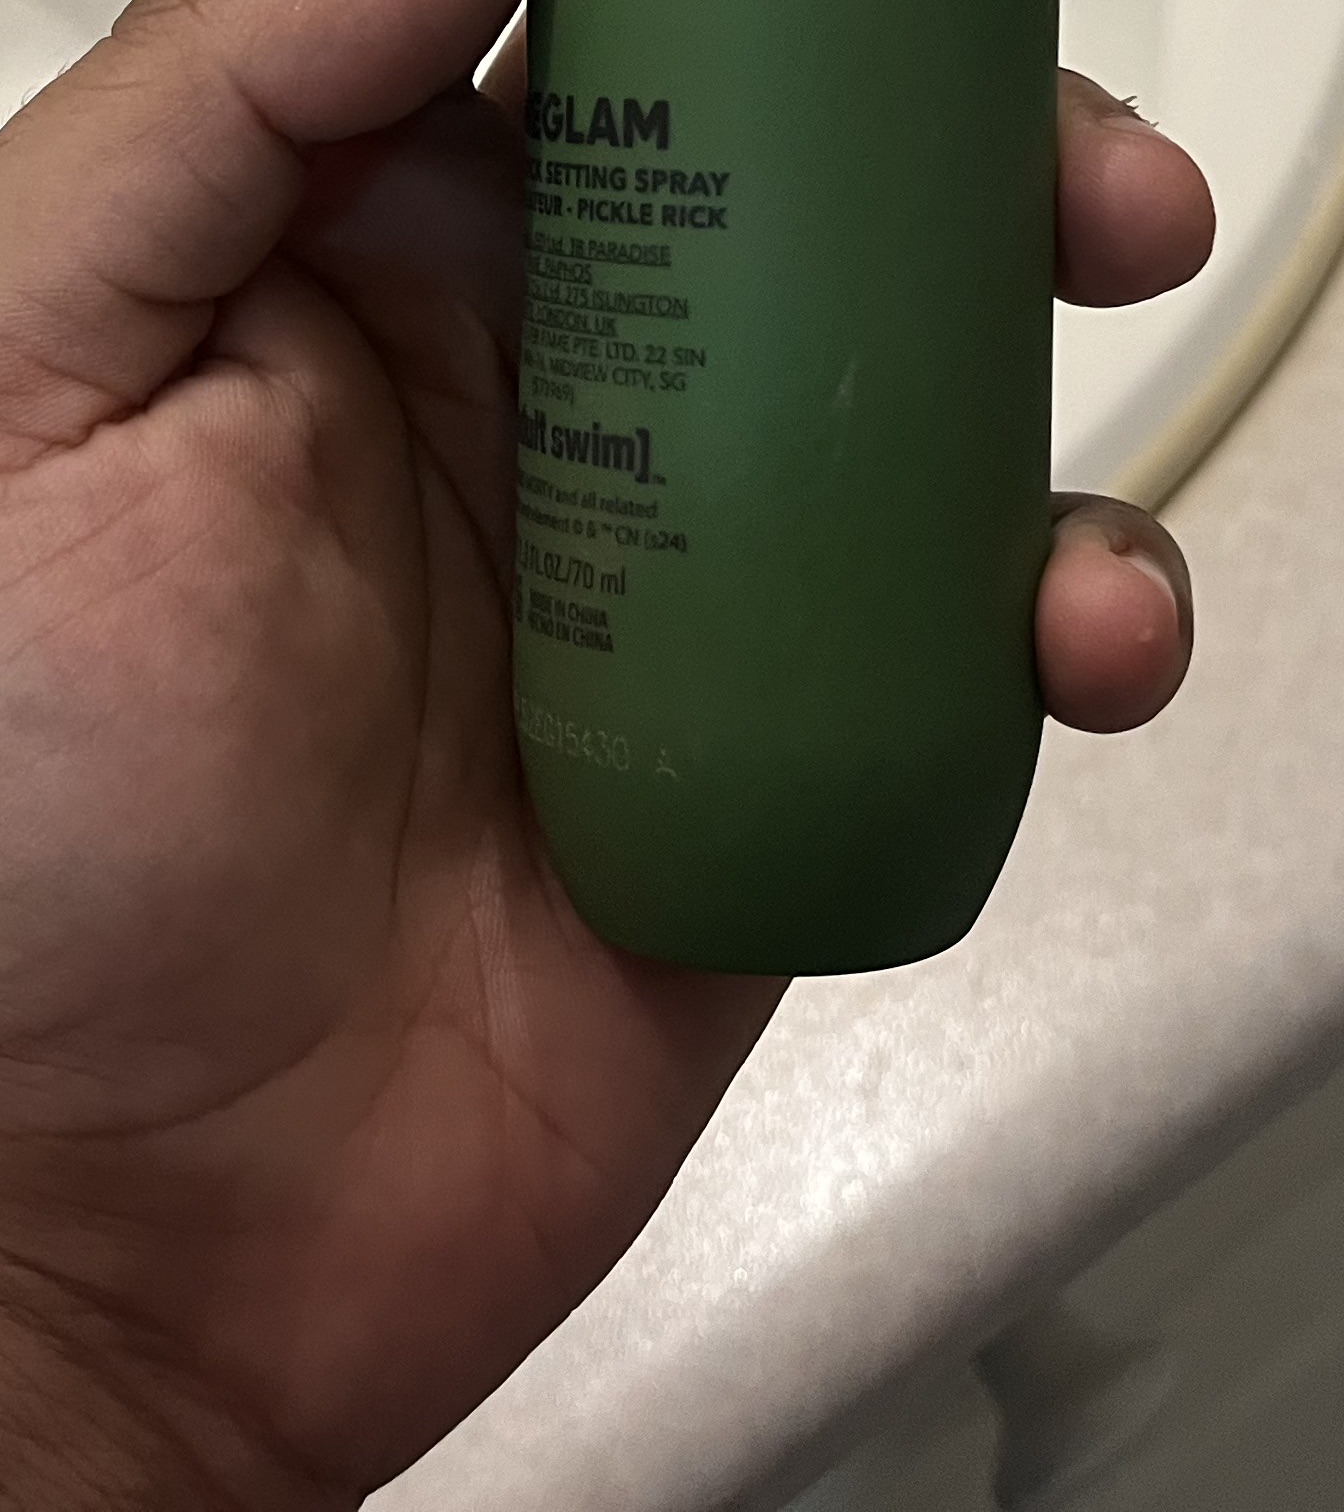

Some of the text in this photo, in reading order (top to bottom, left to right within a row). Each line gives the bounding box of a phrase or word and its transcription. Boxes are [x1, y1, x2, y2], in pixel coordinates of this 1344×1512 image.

[546, 160, 628, 192] SETTING
[635, 168, 731, 197] SPRAY
[577, 197, 654, 227] PICKLE
[661, 204, 728, 230] RICK
[600, 564, 626, 596] ml
